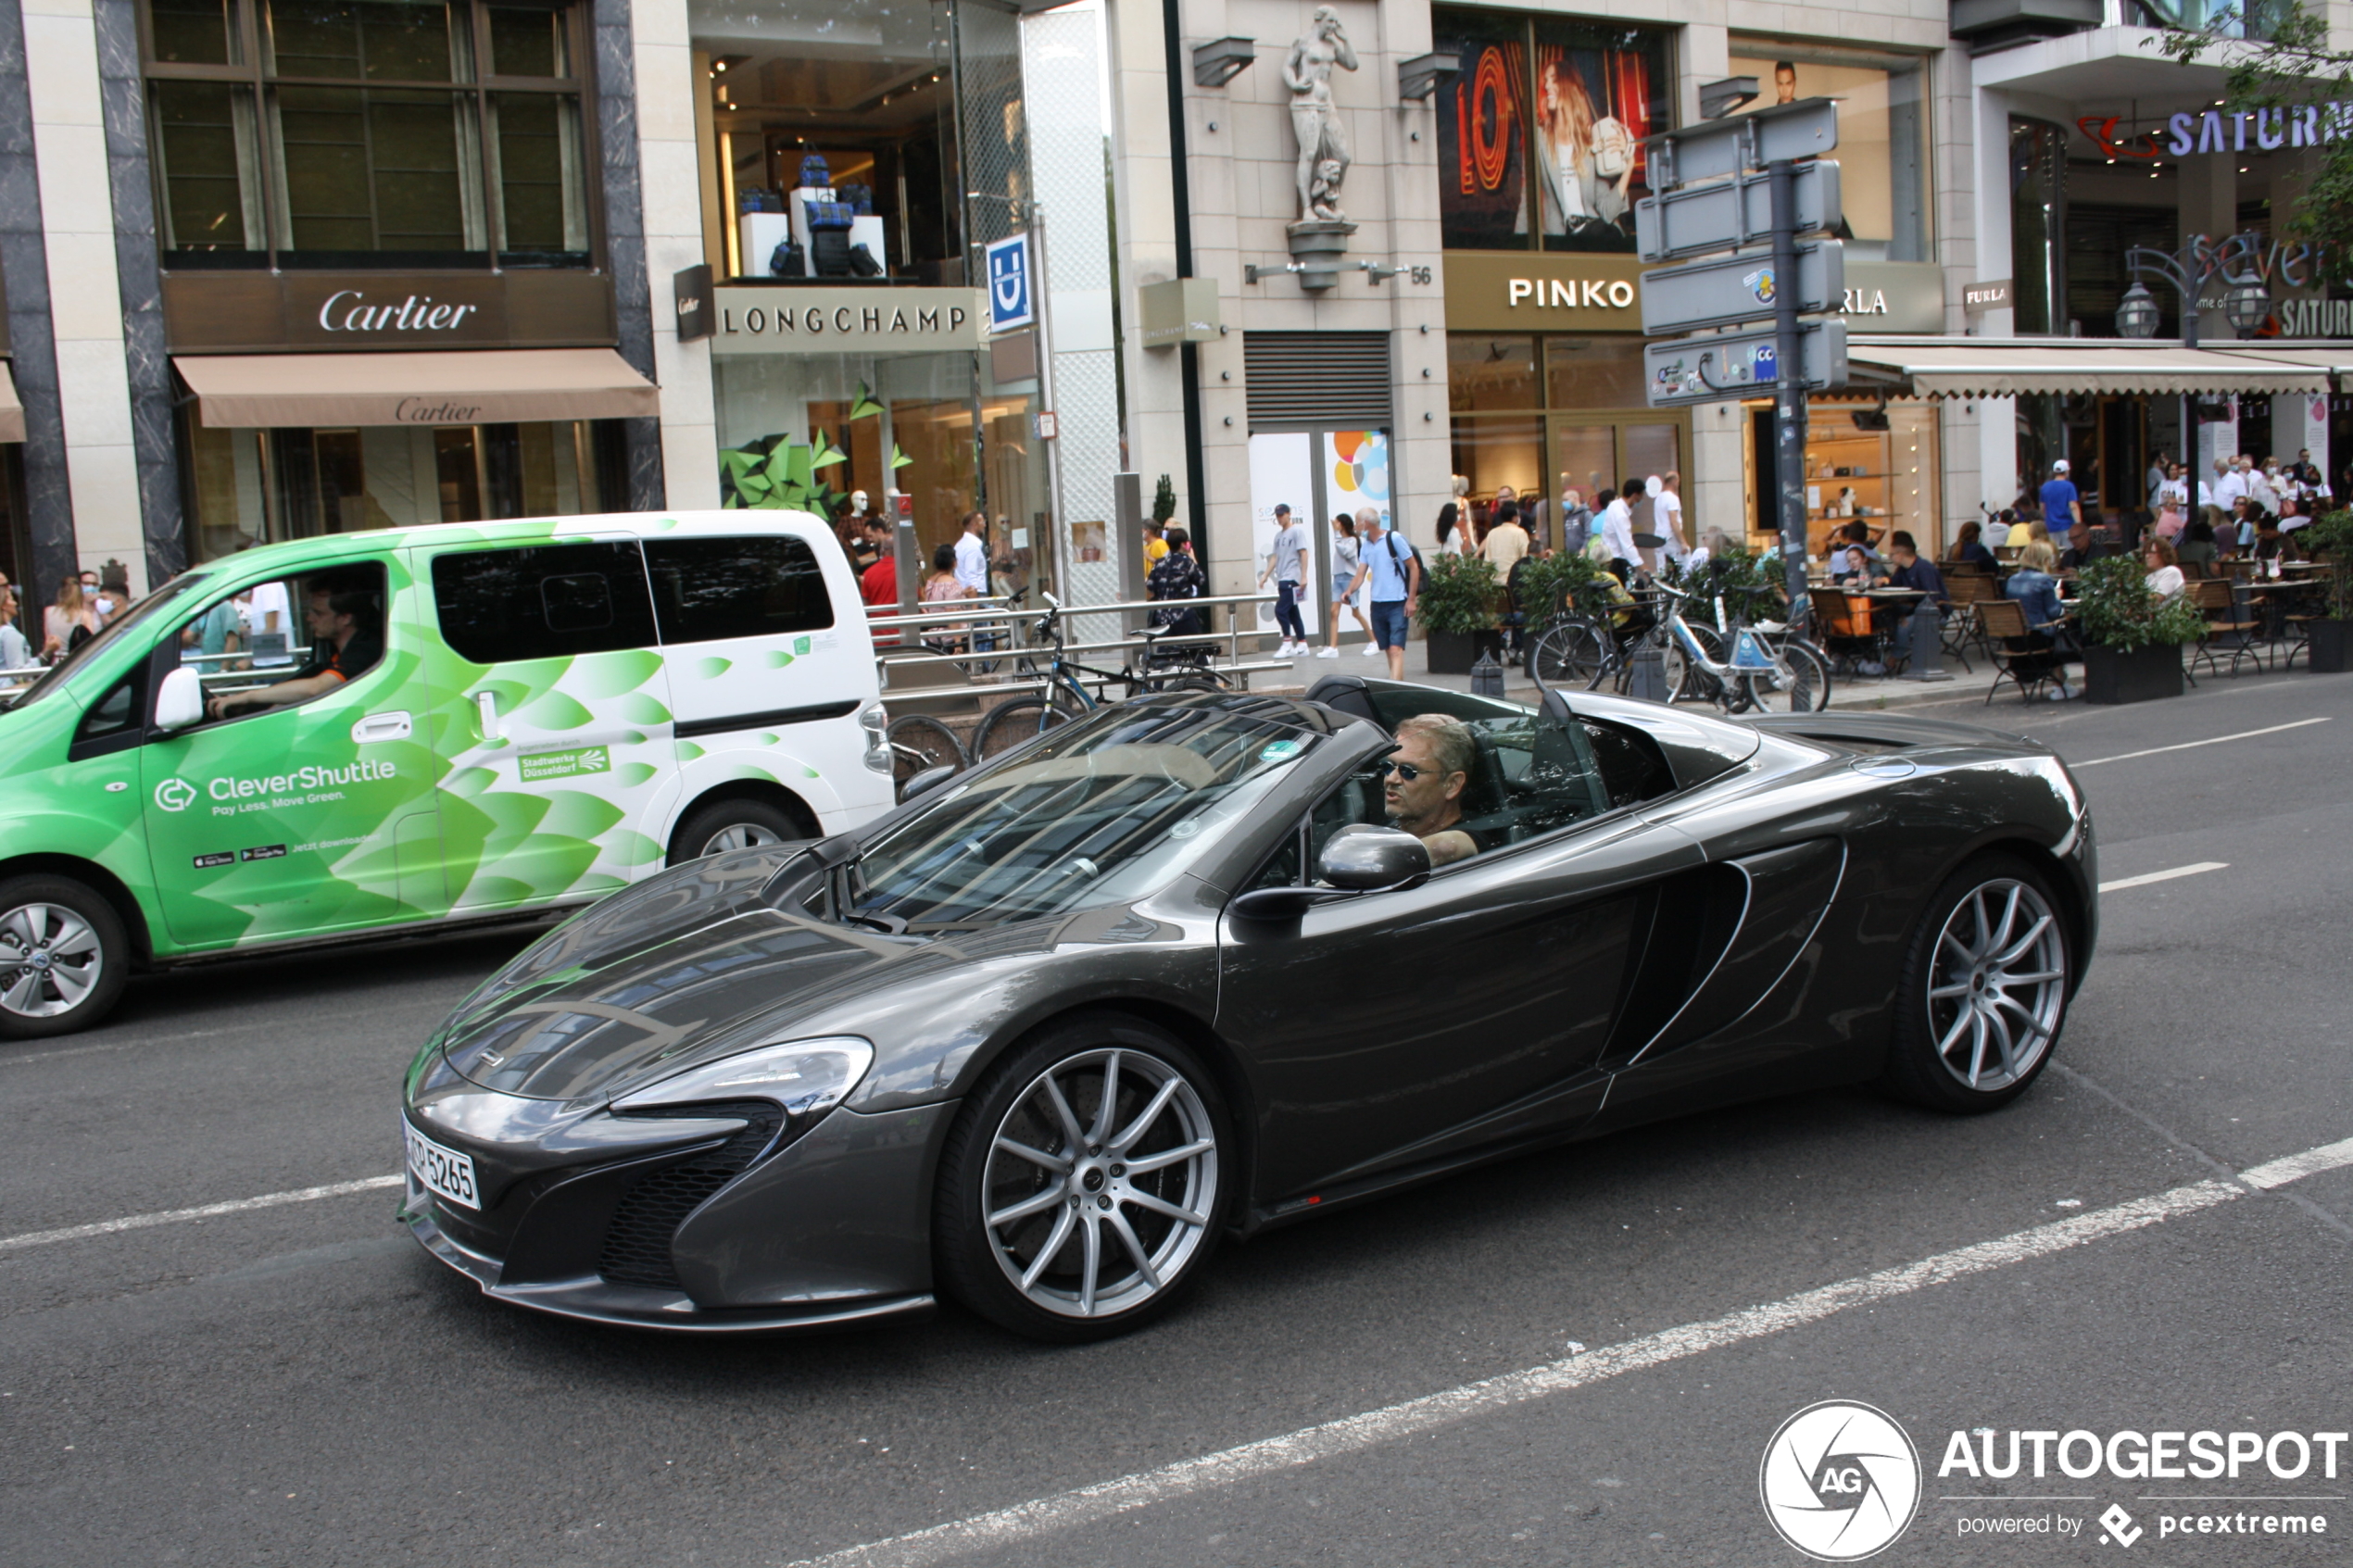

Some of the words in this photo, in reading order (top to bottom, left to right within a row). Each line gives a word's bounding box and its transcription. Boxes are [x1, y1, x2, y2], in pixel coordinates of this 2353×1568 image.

[1411, 266, 1431, 284] 56
[1509, 278, 1634, 307] PINKO
[1839, 288, 1888, 314] RLA
[1967, 287, 2007, 305] FURLA
[319, 289, 477, 332] Cartier
[722, 306, 965, 334] LONGCHAMP
[2281, 299, 2353, 337] SATUR
[395, 395, 482, 422] Cartier
[516, 742, 560, 753] Angetrieben
[522, 754, 575, 768] Stadtwerke
[523, 763, 577, 778] Düsseldorf
[208, 759, 396, 800] CleverShuttle
[212, 805, 235, 817] Pay
[238, 800, 270, 813] Less.
[272, 795, 304, 808] Move
[307, 791, 346, 804] Green.
[292, 840, 317, 853] Jetzt
[427, 1148, 473, 1200] 5265
